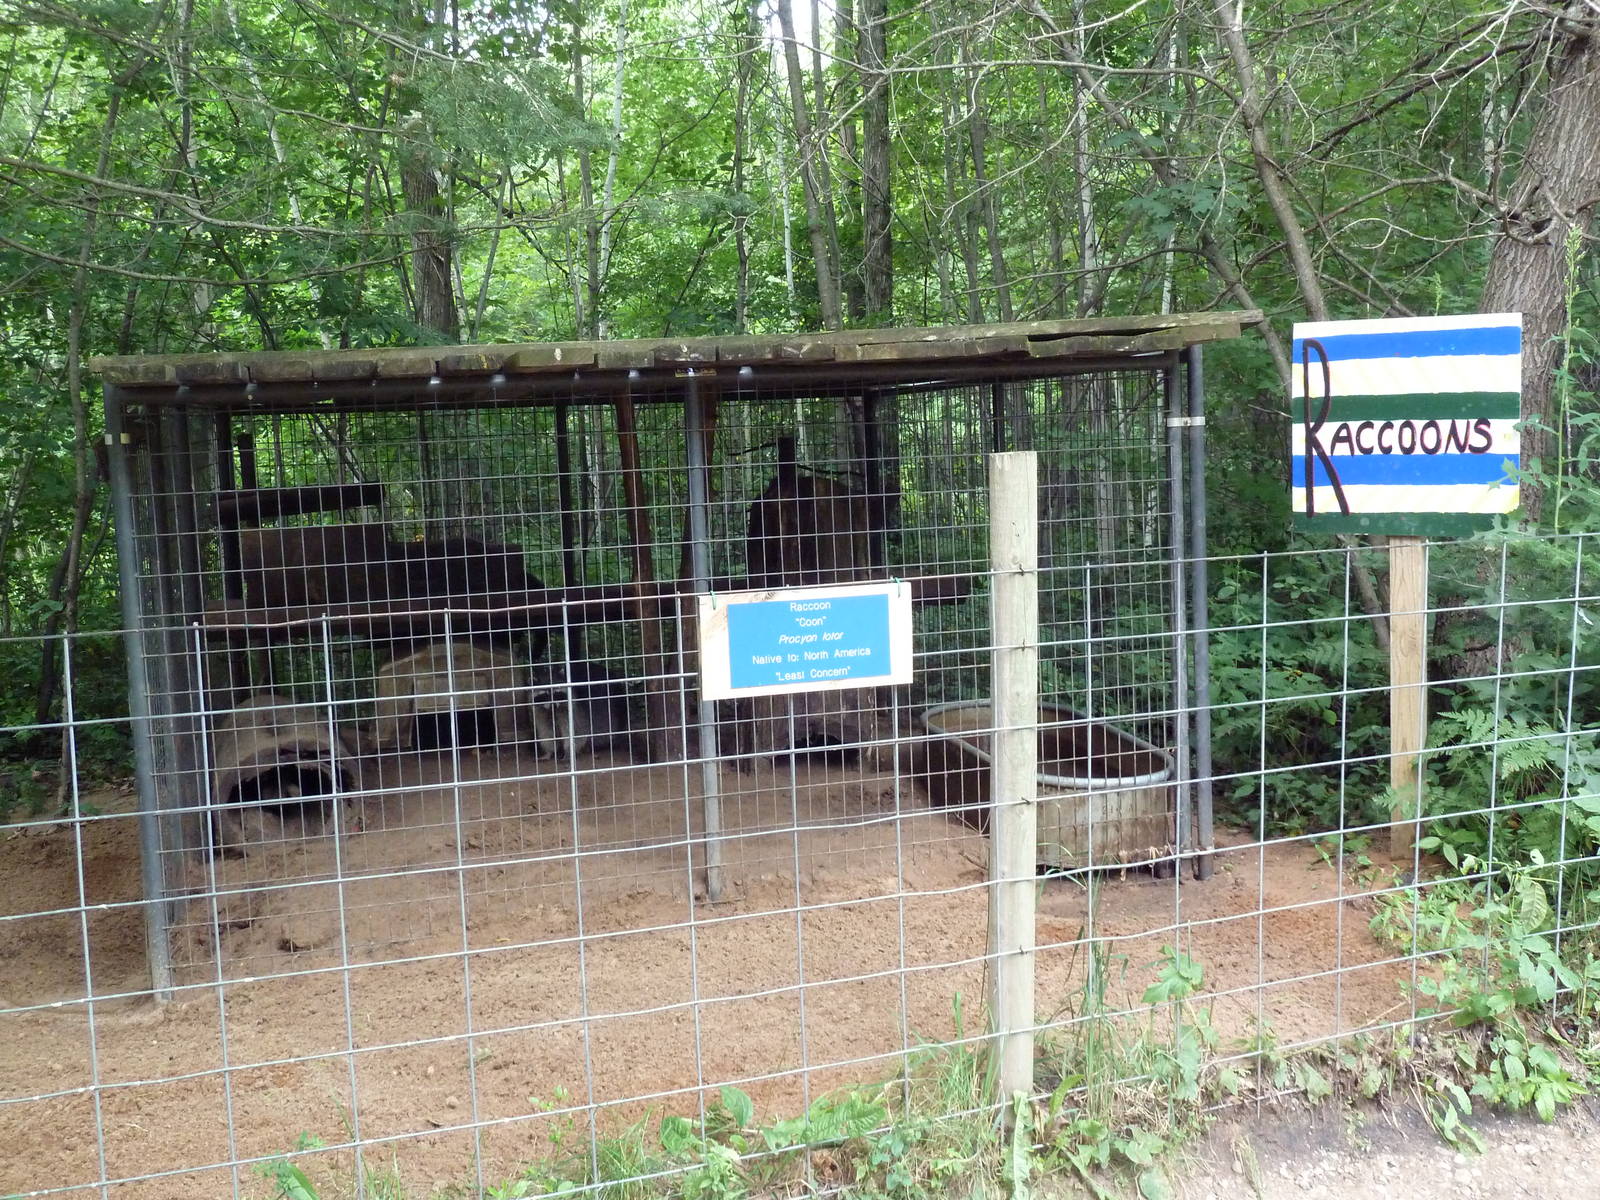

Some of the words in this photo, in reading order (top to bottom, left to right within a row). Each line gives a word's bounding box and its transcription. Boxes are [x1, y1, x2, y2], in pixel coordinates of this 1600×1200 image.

[1303, 338, 1493, 518] RACCOONS
[790, 601, 831, 612] Raccoon
[796, 616, 827, 627] "Coon"
[778, 633, 818, 645] Procyon
[822, 631, 844, 641] lotor
[752, 655, 782, 665] Native
[787, 654, 799, 663] to:
[804, 651, 829, 661] North
[834, 648, 871, 658] America
[775, 671, 805, 681] "Least
[810, 666, 851, 678] Concern"
